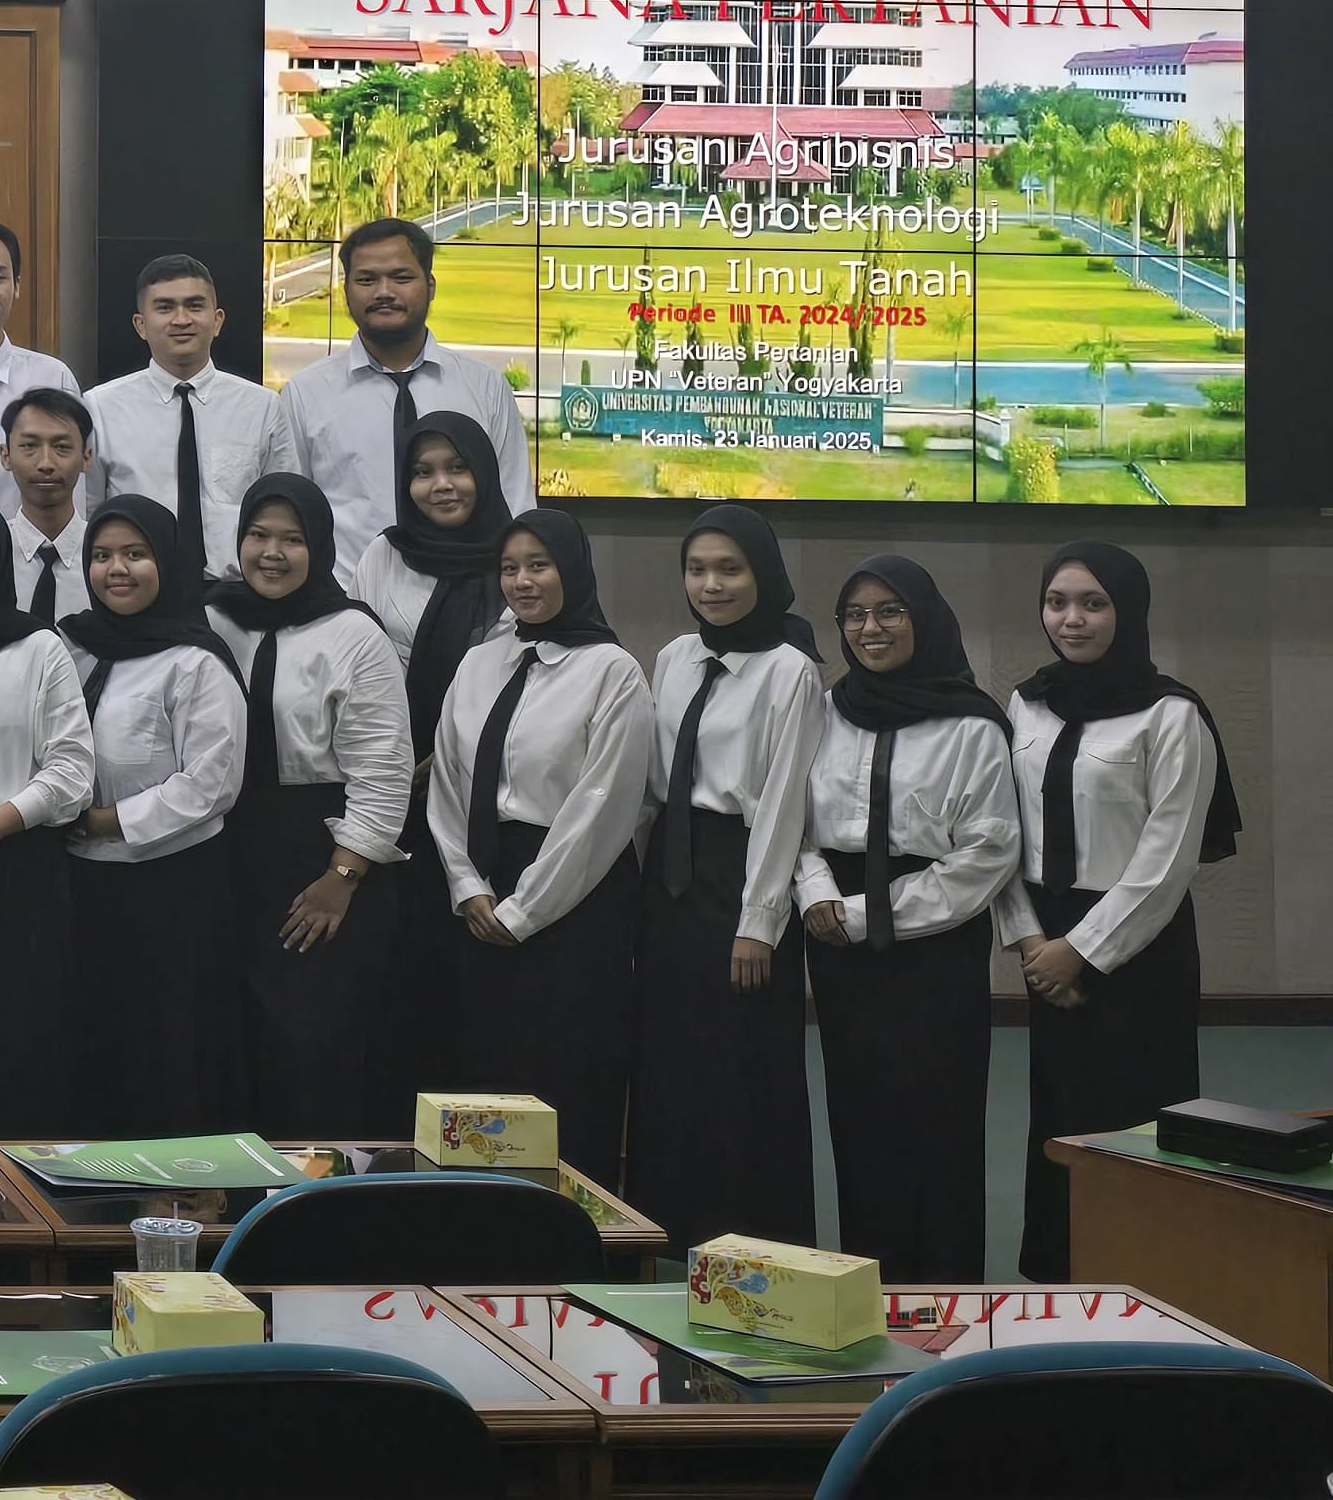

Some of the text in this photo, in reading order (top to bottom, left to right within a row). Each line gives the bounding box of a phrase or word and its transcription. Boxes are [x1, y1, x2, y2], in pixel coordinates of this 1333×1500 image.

[558, 128, 954, 175] Jurusan Agribisnis
[512, 191, 998, 242] Jurusan Agroteknologi
[539, 255, 973, 297] Jurusan Ilmu Tanah
[629, 302, 716, 323] Periode
[729, 304, 751, 324] III
[756, 304, 792, 325] TA.
[654, 339, 858, 362] Fakultas Pertanian
[611, 369, 662, 390] UPN
[780, 372, 903, 397] Yogyakarta
[714, 430, 739, 448] 23
[744, 430, 817, 449] Januari
[822, 431, 872, 450] 2025
